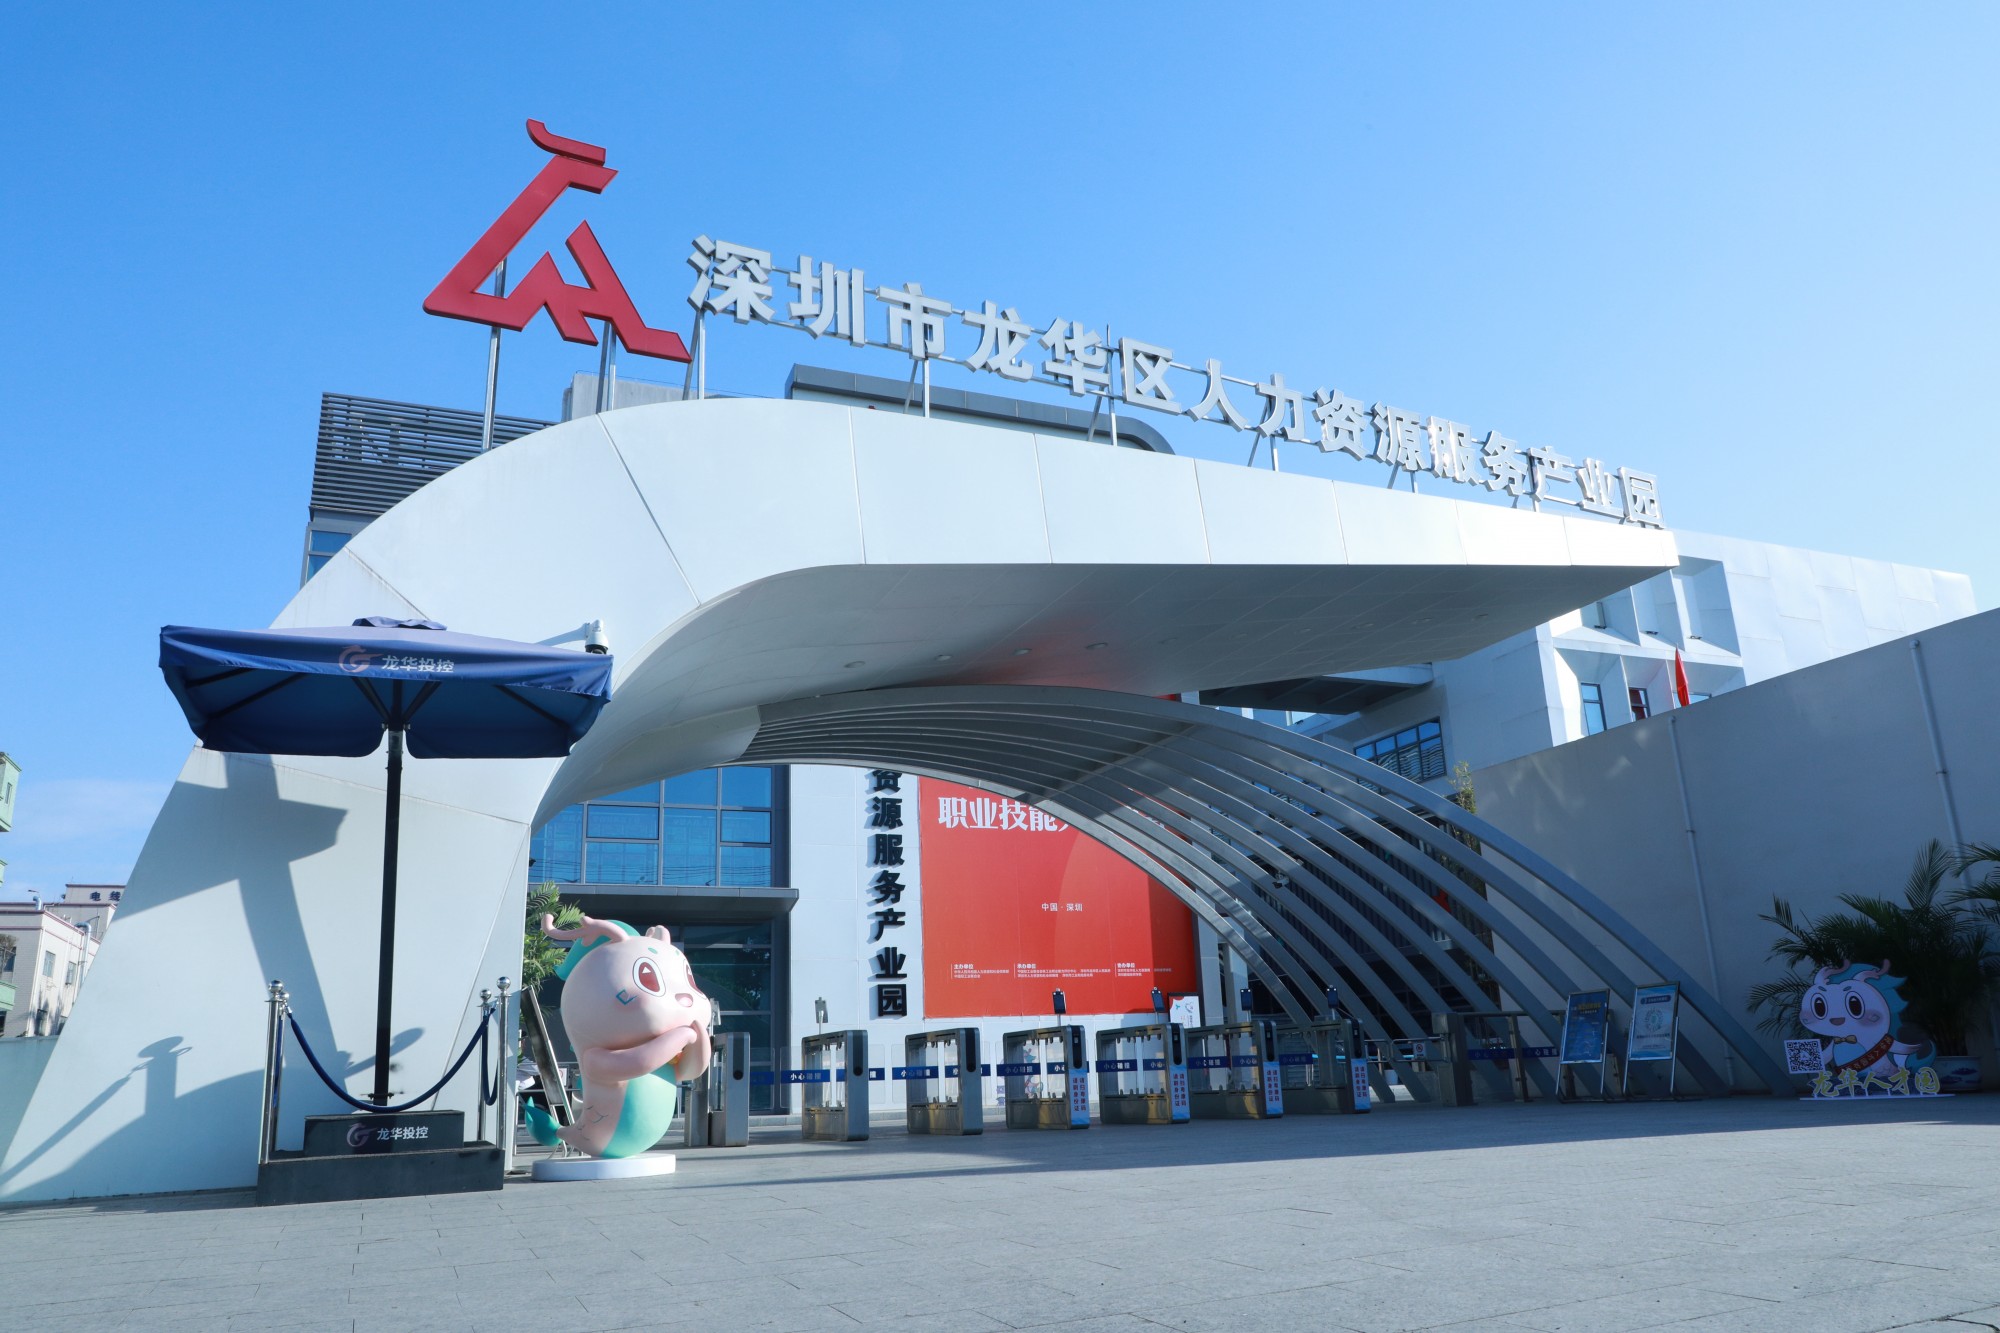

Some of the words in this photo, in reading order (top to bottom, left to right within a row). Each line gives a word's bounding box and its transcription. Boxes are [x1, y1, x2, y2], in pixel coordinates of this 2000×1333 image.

[686, 234, 1666, 530] 深圳市龙华区人力资源服务产业园
[381, 654, 455, 673] 龙华投控
[938, 796, 1069, 833] 职业技能
[376, 1125, 429, 1141] 龙华投控
